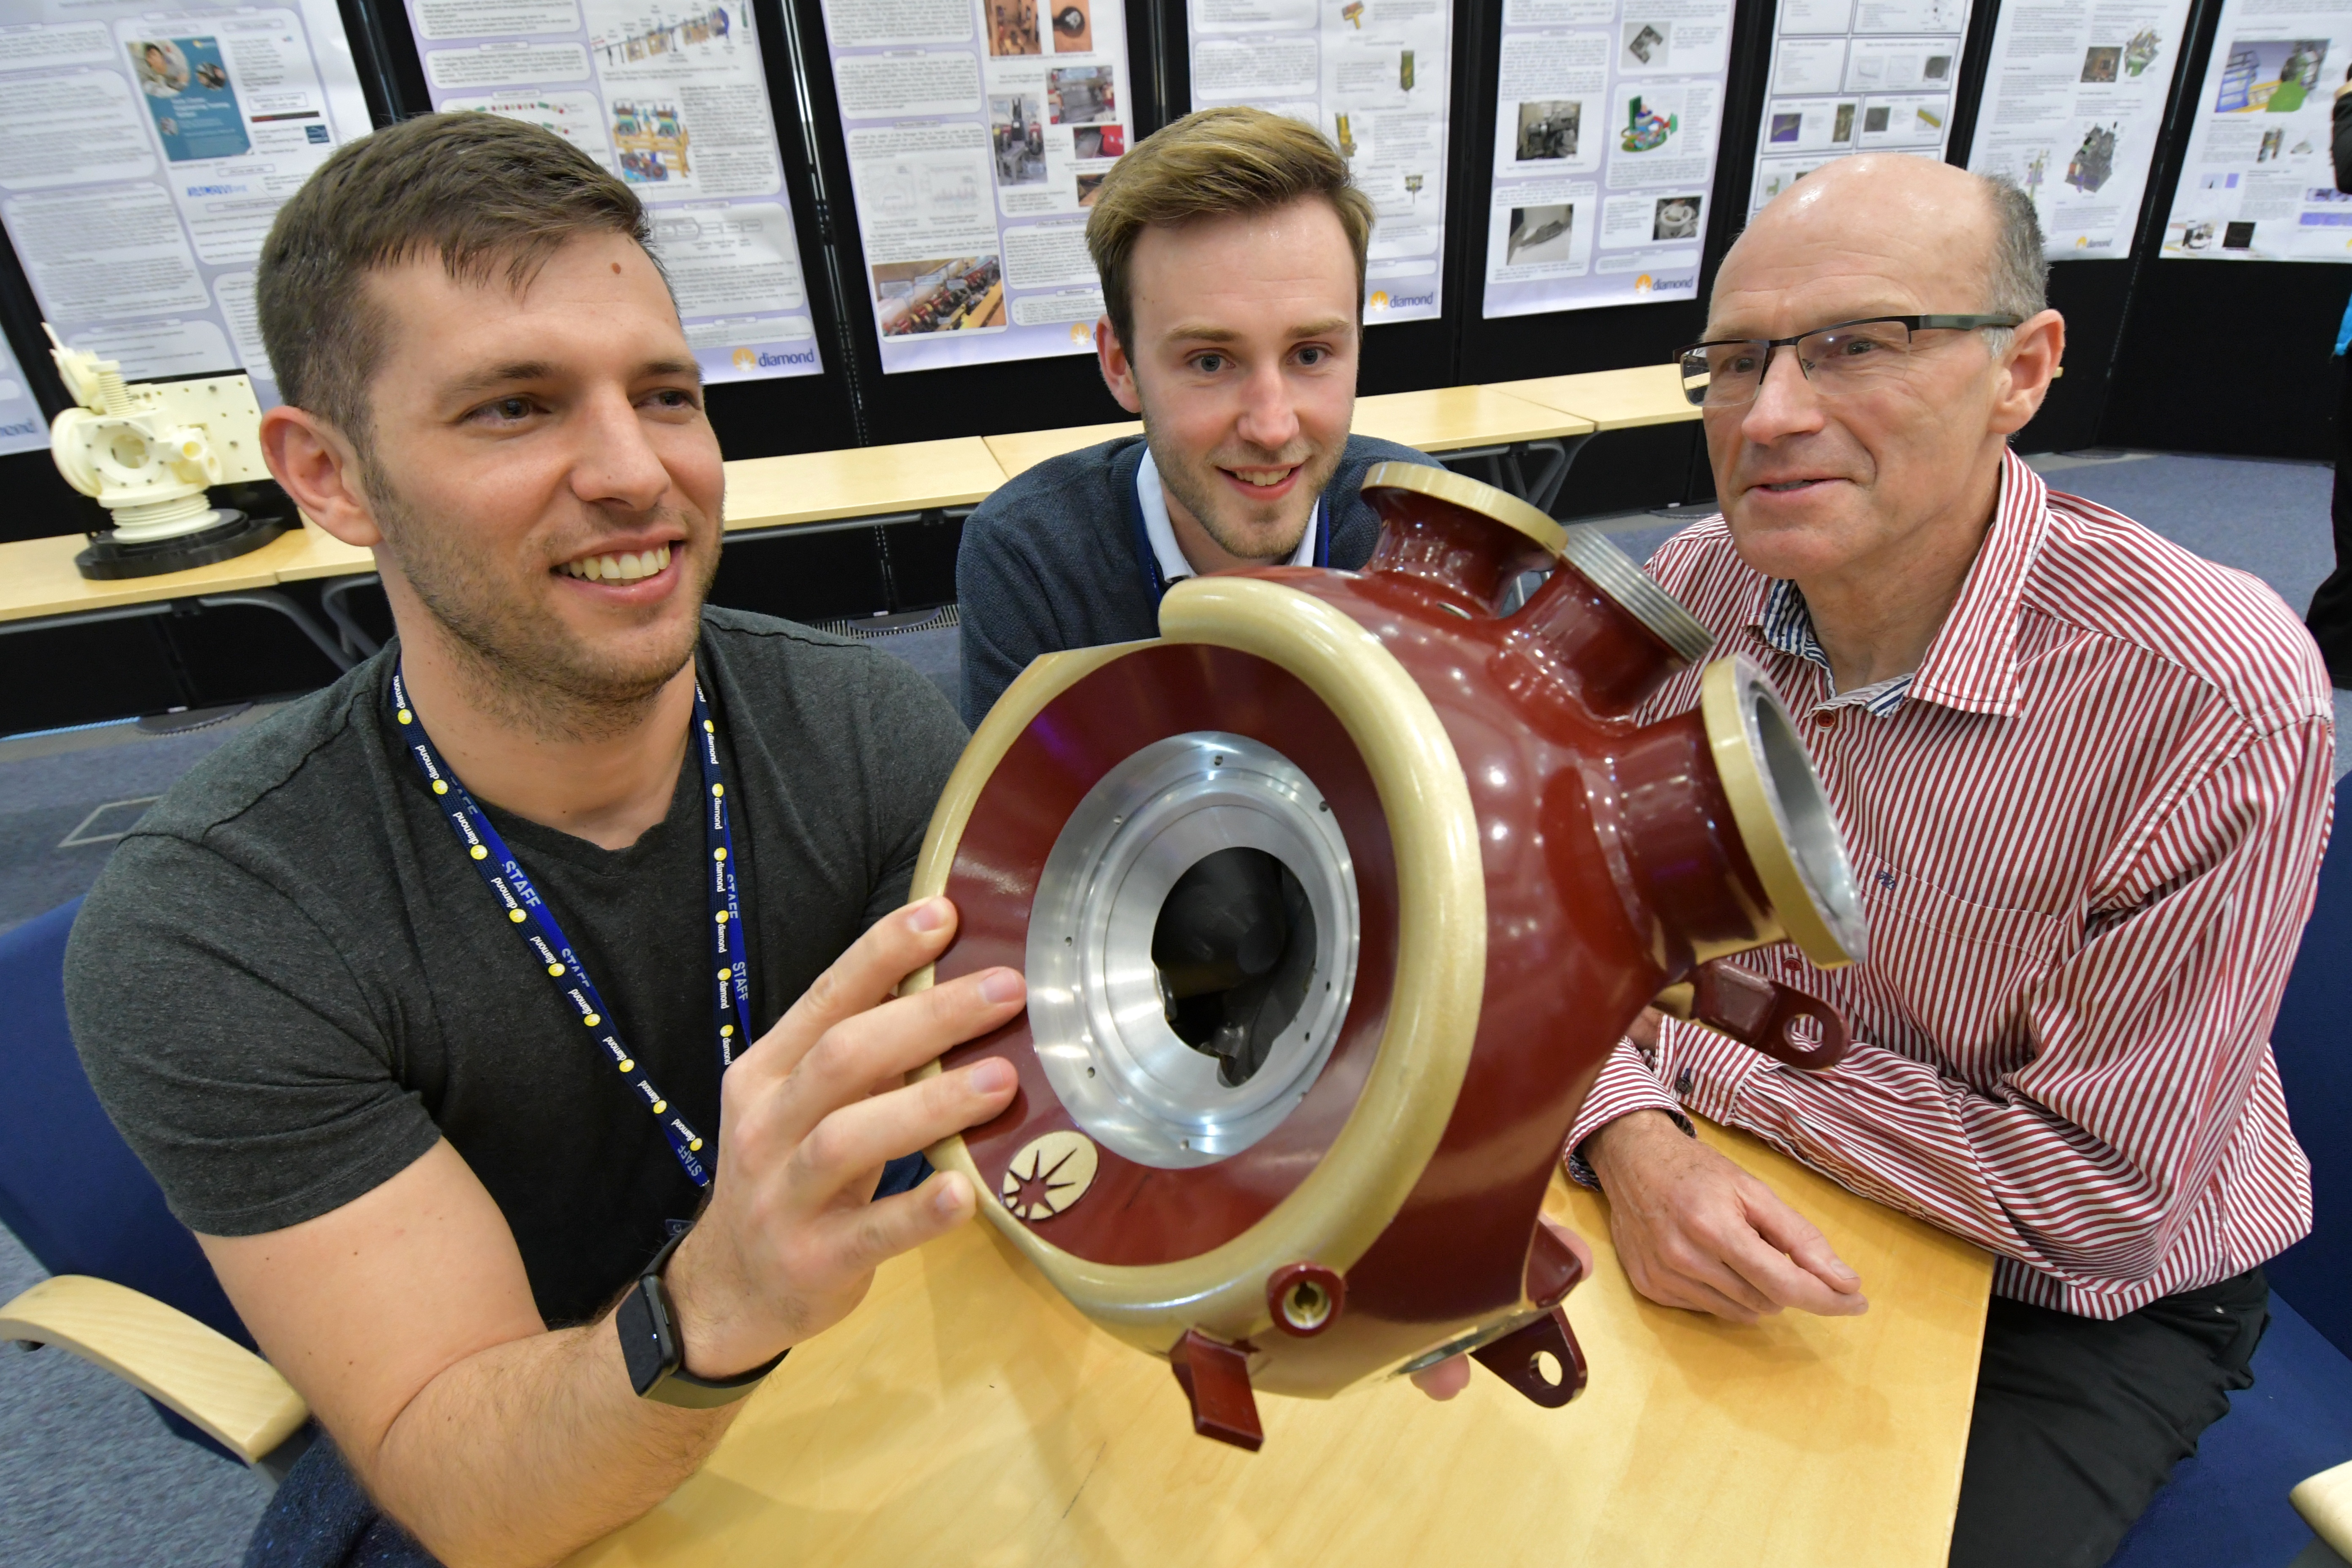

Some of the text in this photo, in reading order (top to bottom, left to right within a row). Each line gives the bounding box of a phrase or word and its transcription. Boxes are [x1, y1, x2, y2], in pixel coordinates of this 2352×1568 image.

[1653, 275, 1693, 291] diamond
[1390, 291, 1433, 308] diamond
[759, 348, 814, 367] diamond
[415, 745, 440, 779] diamond
[707, 733, 719, 764] diamond
[452, 811, 479, 845] diamond
[714, 798, 723, 830] diamond
[502, 860, 541, 907] STAFF
[716, 861, 726, 893] diamond
[490, 877, 518, 909] diamond
[530, 936, 557, 964] diamond
[718, 923, 727, 953] diamond
[720, 981, 730, 1009] diamond
[732, 961, 749, 1001] STAFF
[567, 988, 593, 1015] diamond
[602, 1036, 627, 1061] diamond
[723, 1037, 734, 1065] diamond
[637, 1080, 660, 1103] diamond
[671, 1119, 696, 1141] diamond
[678, 1145, 702, 1176] STAFF
